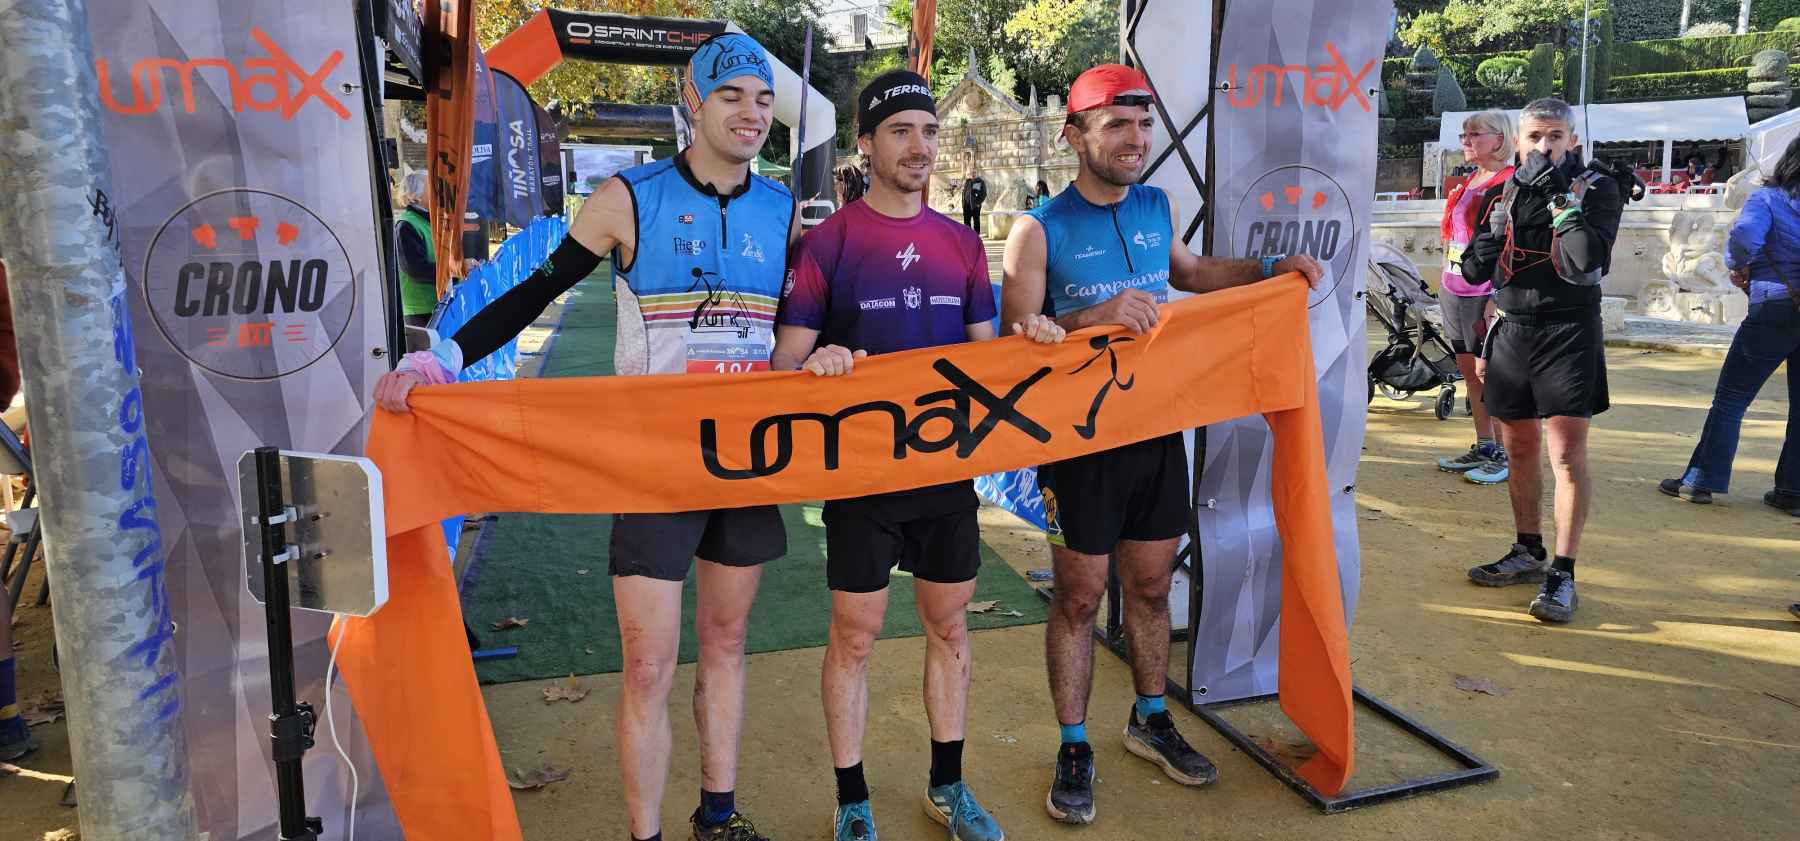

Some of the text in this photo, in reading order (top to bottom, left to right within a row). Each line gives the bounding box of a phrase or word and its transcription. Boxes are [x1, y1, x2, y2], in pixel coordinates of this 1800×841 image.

[95, 27, 352, 122] umax
[1227, 40, 1377, 112] umax
[1246, 219, 1341, 261] CRONO
[173, 258, 328, 318] CRONO
[700, 357, 1053, 481] umax
